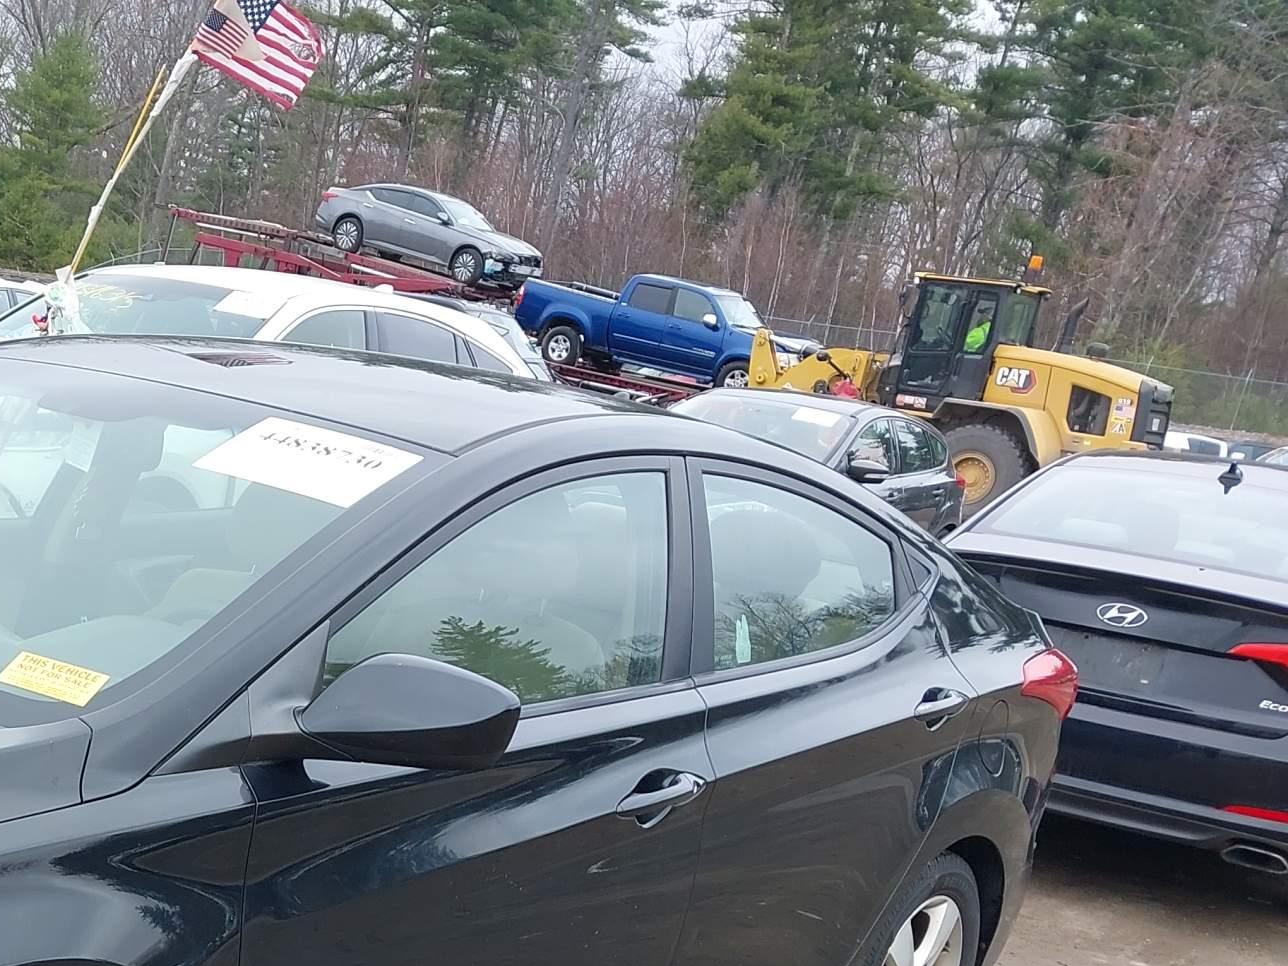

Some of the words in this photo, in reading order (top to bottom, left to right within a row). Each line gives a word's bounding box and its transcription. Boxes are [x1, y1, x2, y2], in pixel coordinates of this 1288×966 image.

[996, 366, 1030, 389] CAT
[17, 663, 38, 673] NOT
[40, 668, 61, 681] FOR
[64, 676, 89, 689] SALE
[22, 654, 50, 668] THIS
[51, 662, 101, 684] VEHICLE
